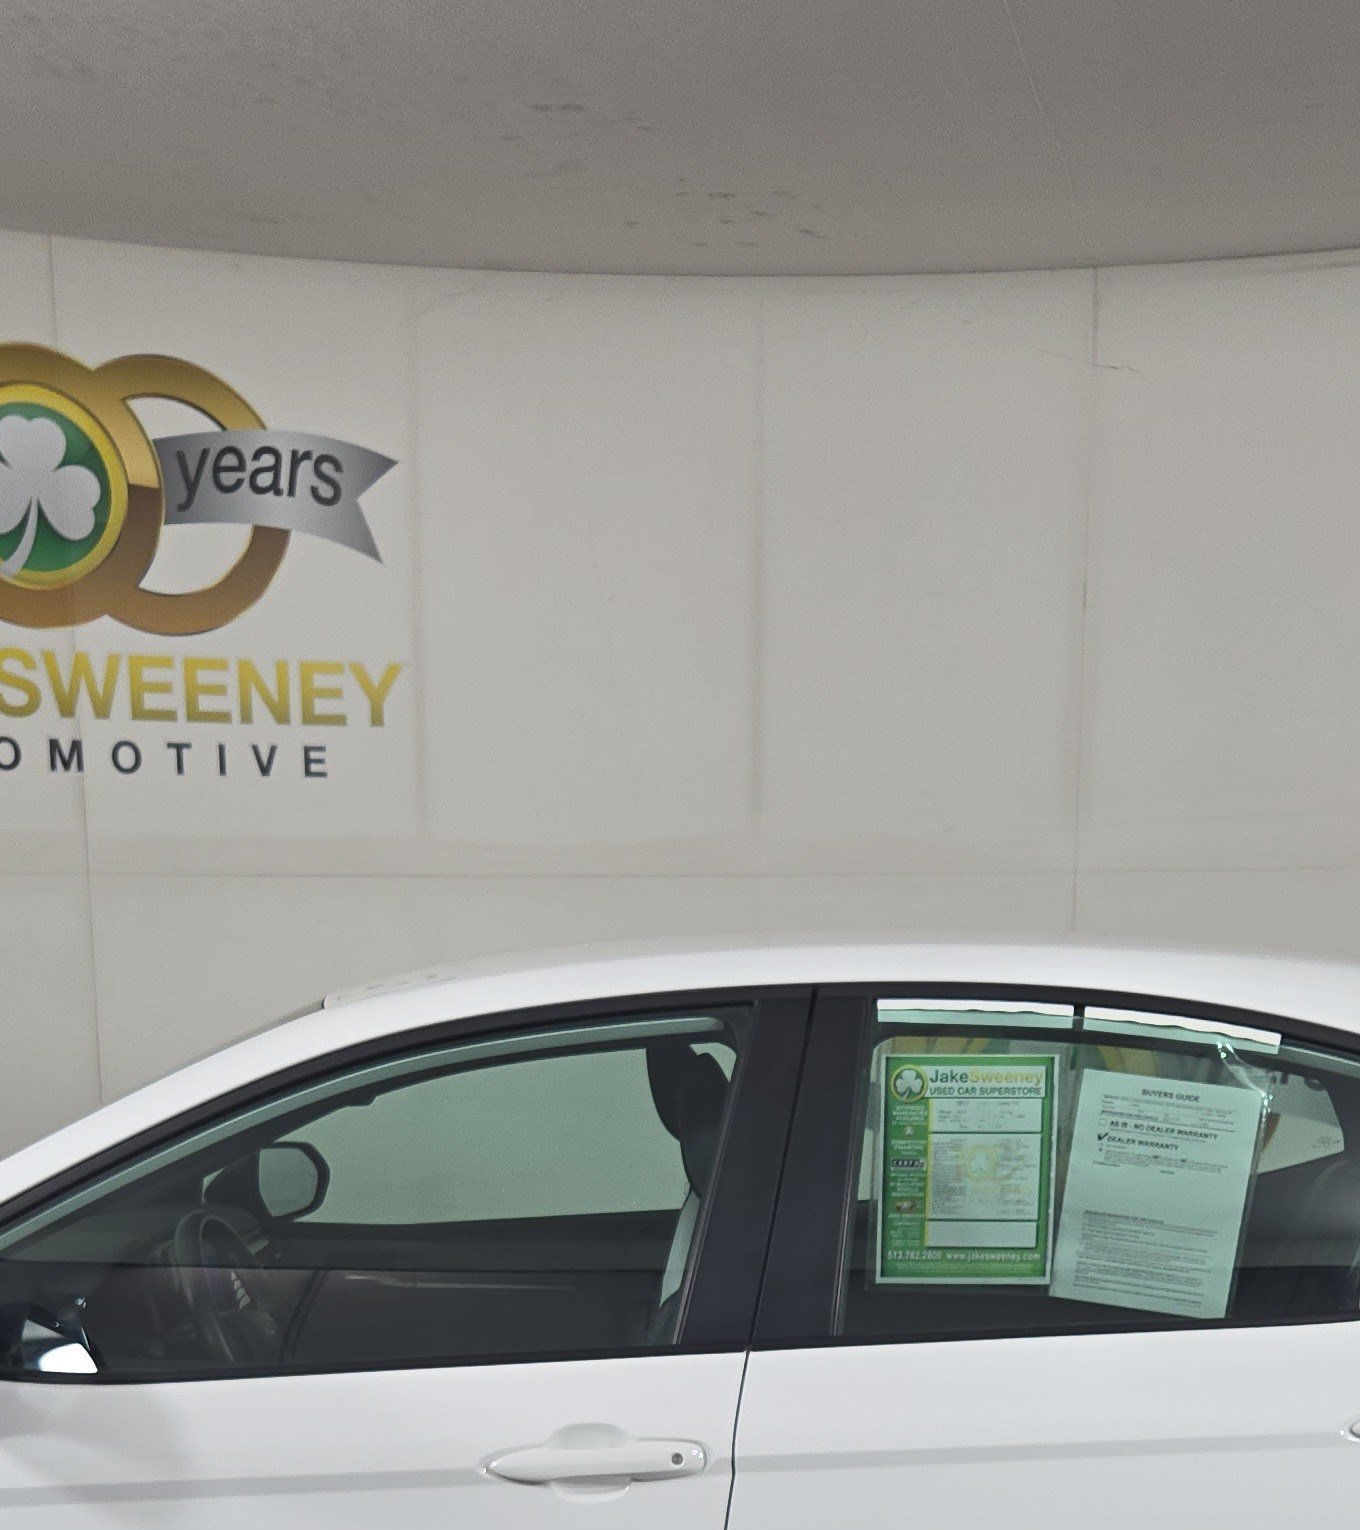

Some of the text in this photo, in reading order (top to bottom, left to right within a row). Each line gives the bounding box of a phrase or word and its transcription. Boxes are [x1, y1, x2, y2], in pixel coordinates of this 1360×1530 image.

[175, 444, 343, 513] years
[929, 1087, 1042, 1096] USED CAR SUPERSTORE
[1145, 1124, 1176, 1135] DEALER
[1177, 1129, 1219, 1141] WARRANTY
[1106, 1135, 1181, 1151] DEALER WARRANTY
